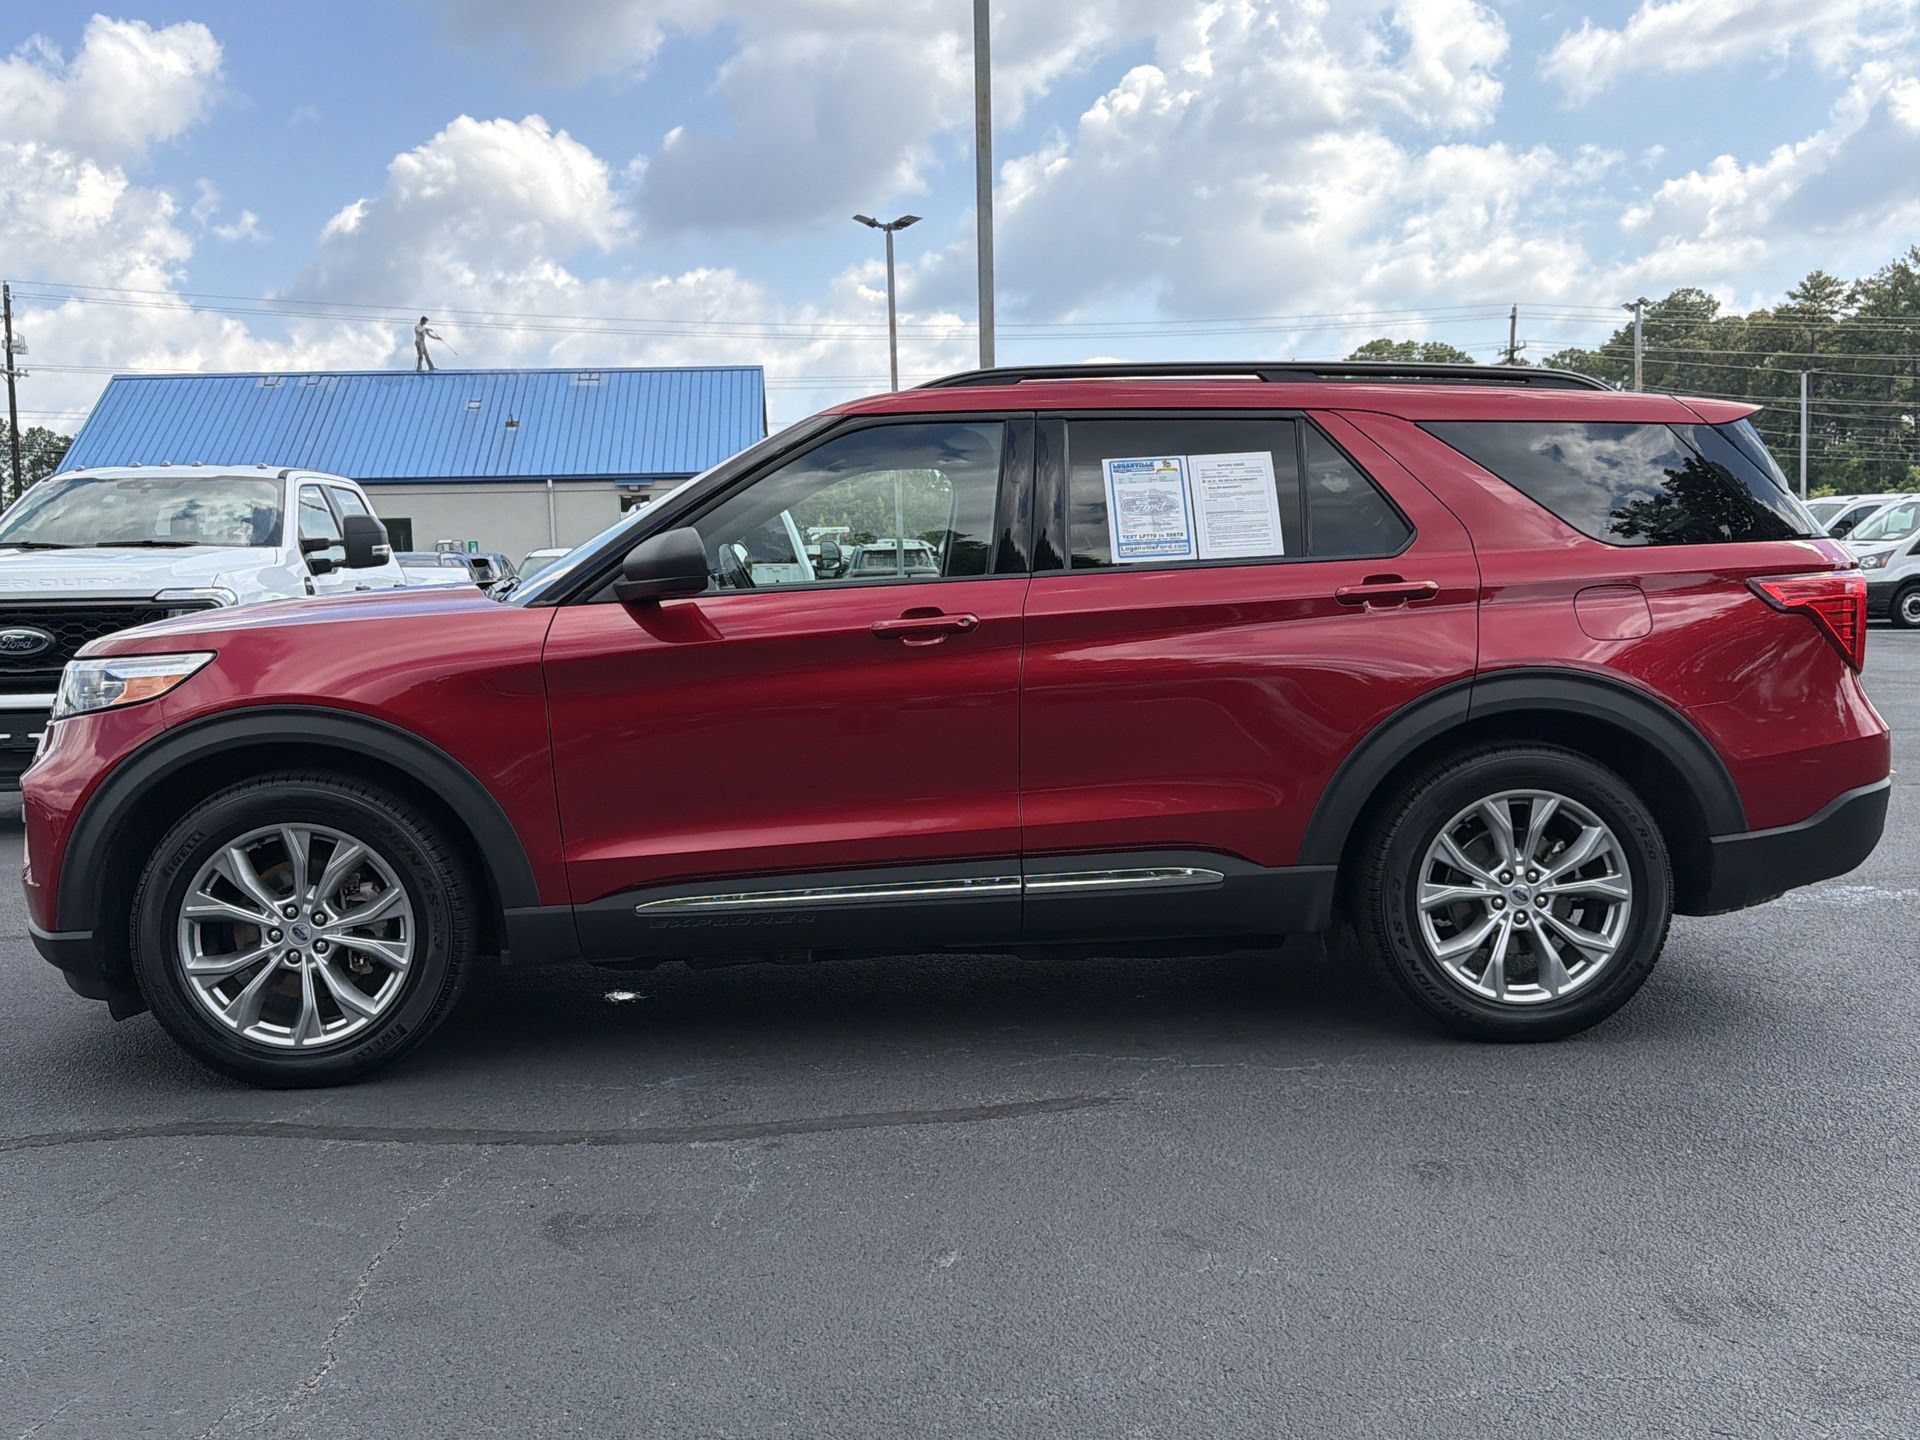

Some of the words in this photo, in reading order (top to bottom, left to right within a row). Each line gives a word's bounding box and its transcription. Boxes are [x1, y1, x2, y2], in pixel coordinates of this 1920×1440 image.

[1113, 461, 1154, 469] LOGANVILLE
[1120, 544, 1188, 552] LoganvilleFord.com
[0, 634, 33, 649] Ford
[650, 912, 816, 929] EXPLORER
